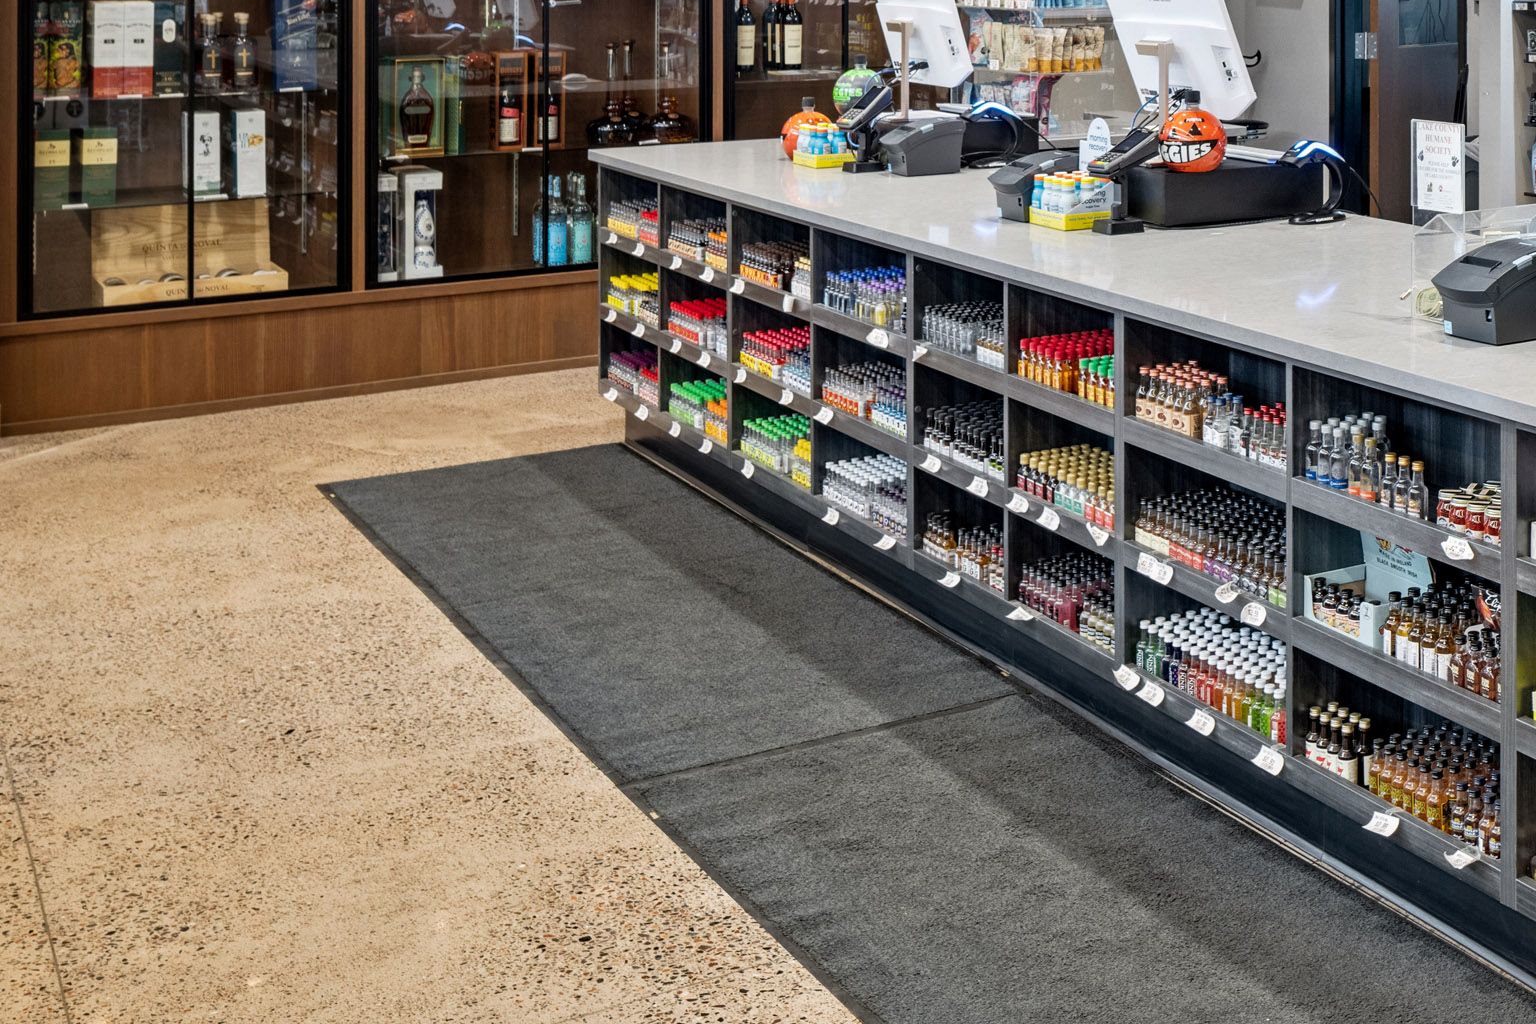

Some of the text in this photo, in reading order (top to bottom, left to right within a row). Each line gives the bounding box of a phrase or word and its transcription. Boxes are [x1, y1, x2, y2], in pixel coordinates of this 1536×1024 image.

[1418, 122, 1459, 133] LAKE COUNTY
[1425, 134, 1451, 144] HUMANE
[1160, 142, 1212, 164] GGIES
[1425, 146, 1451, 155] SOCIETY
